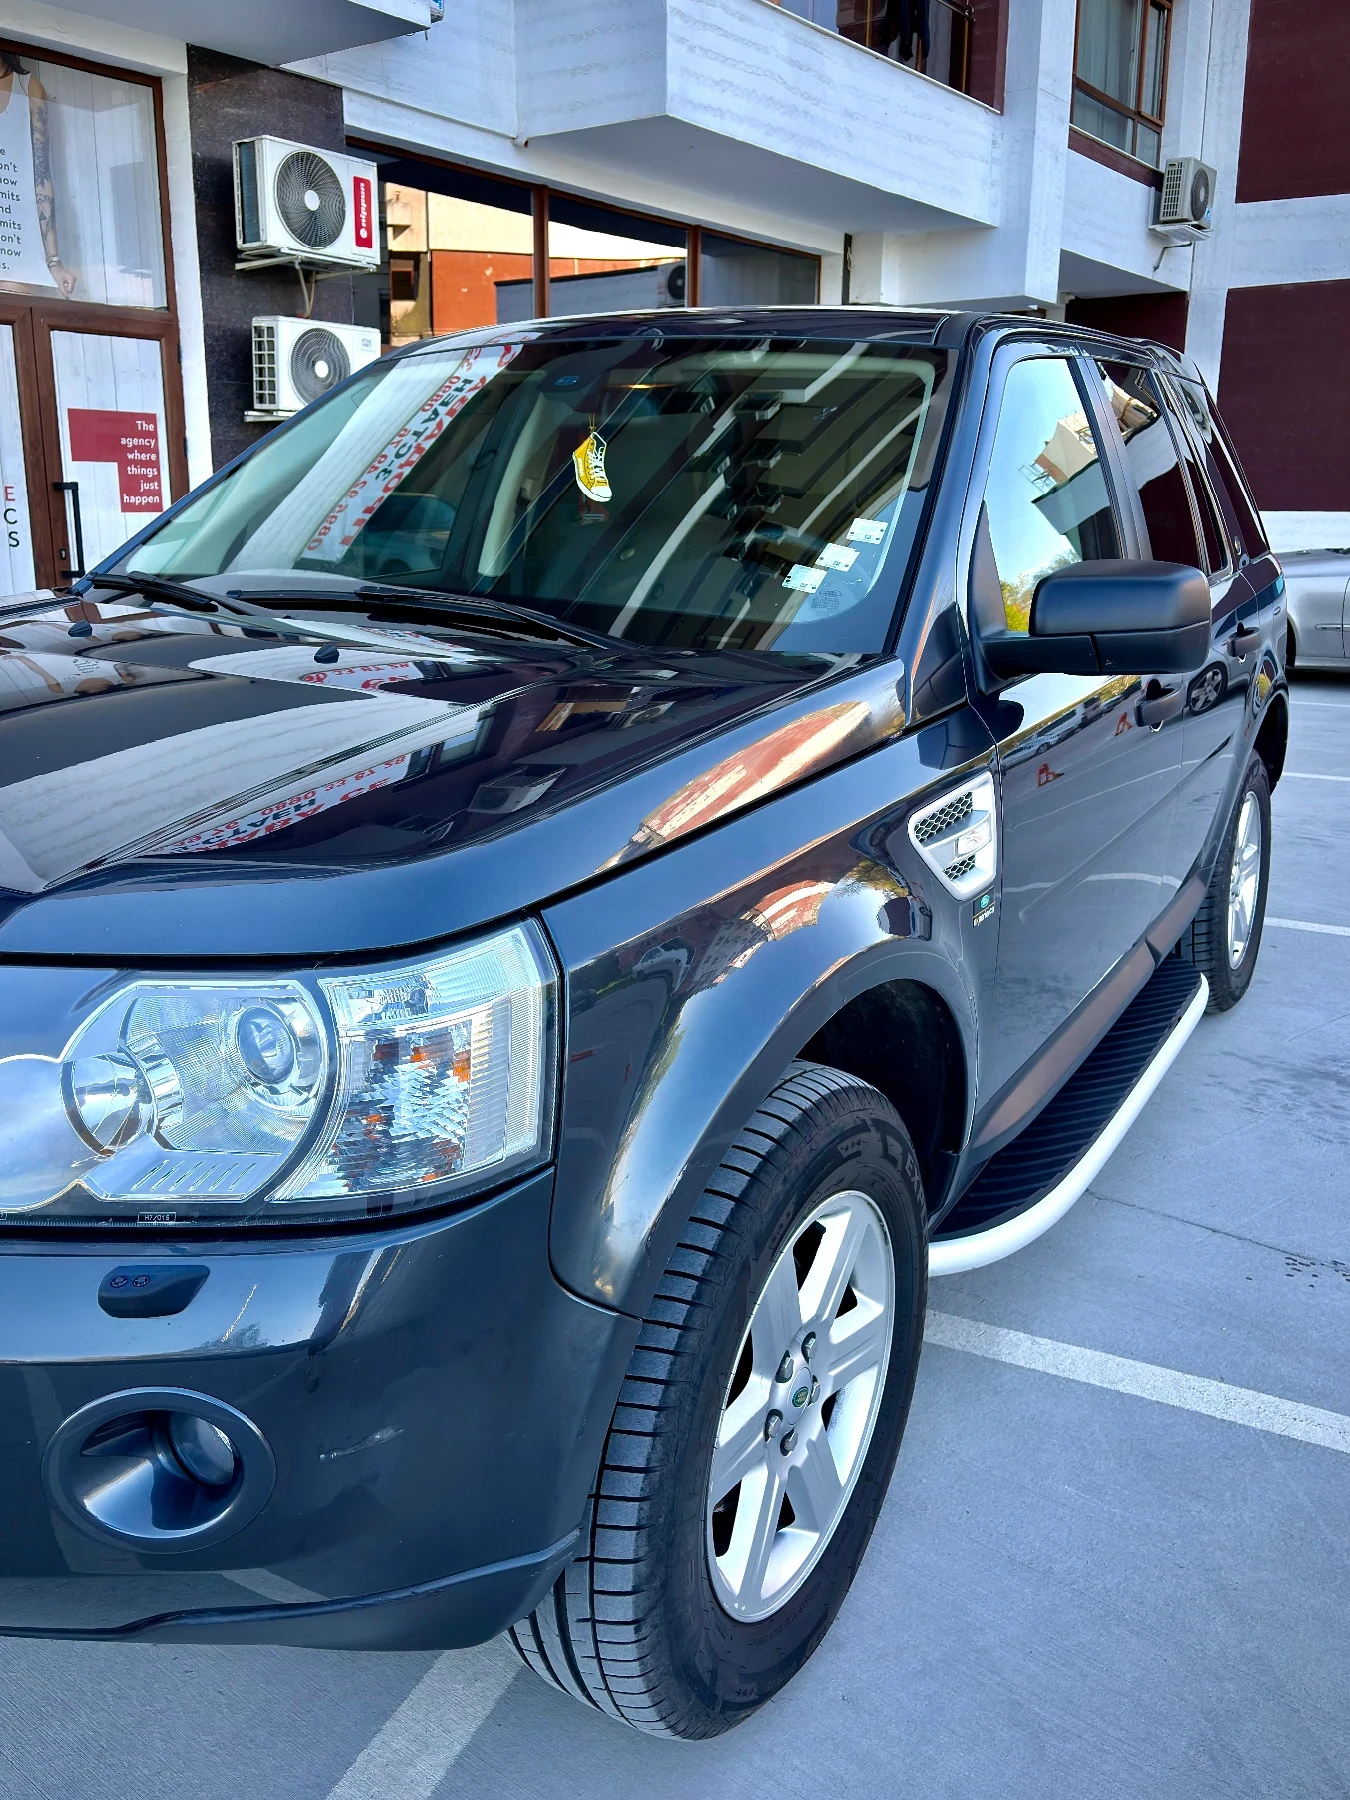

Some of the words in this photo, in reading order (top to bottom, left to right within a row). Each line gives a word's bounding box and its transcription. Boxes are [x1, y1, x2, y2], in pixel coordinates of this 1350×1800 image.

[136, 420, 155, 432] The
[120, 437, 155, 448] agency
[126, 449, 157, 461] where
[127, 464, 158, 477] things
[140, 480, 159, 492] just
[123, 494, 160, 506] happen
